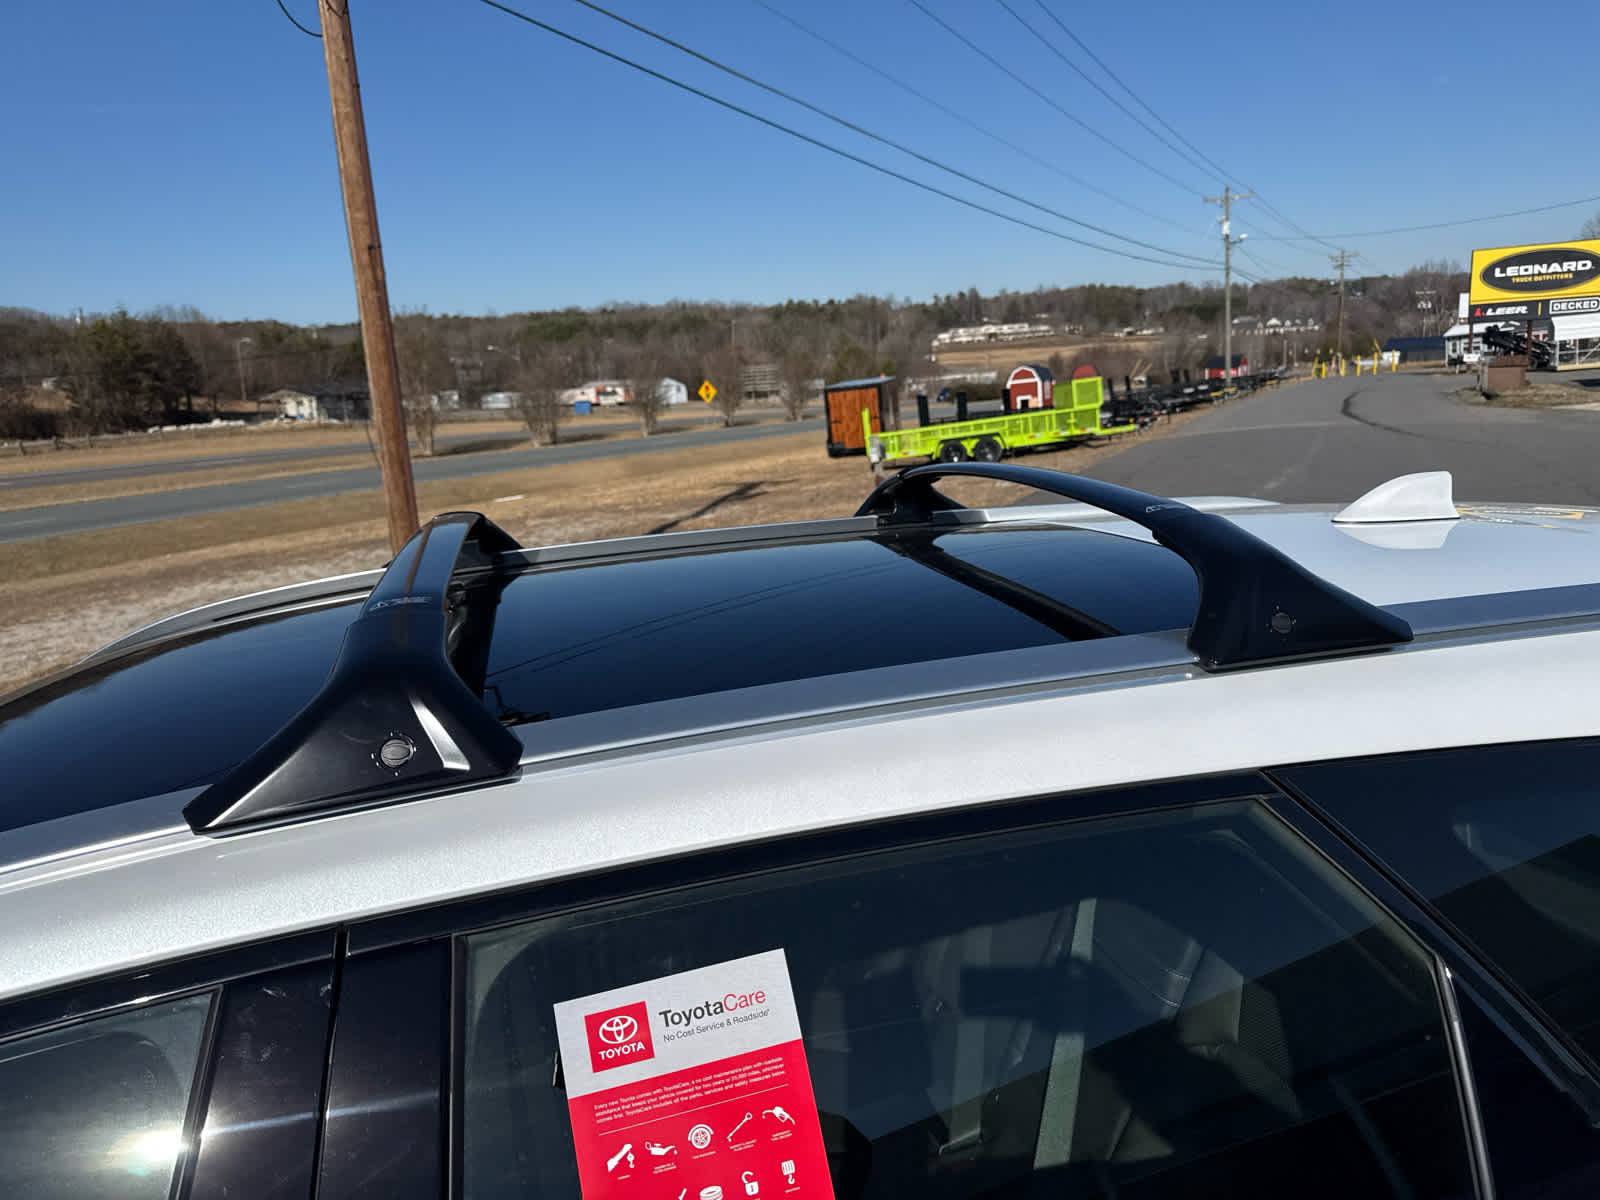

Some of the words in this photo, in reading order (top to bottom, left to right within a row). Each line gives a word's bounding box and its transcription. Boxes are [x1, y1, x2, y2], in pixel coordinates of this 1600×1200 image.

[1494, 260, 1592, 277] LEONARD
[1534, 273, 1573, 282] OUTFITTERS
[1486, 306, 1528, 316] LEER
[1553, 300, 1598, 311] DECKED
[659, 990, 767, 1027] ToyotaCare
[663, 1034, 675, 1042] No
[676, 1027, 695, 1040] Cost
[697, 1021, 725, 1035] Service
[726, 1018, 732, 1026] &
[598, 1041, 646, 1061] TOYOTA
